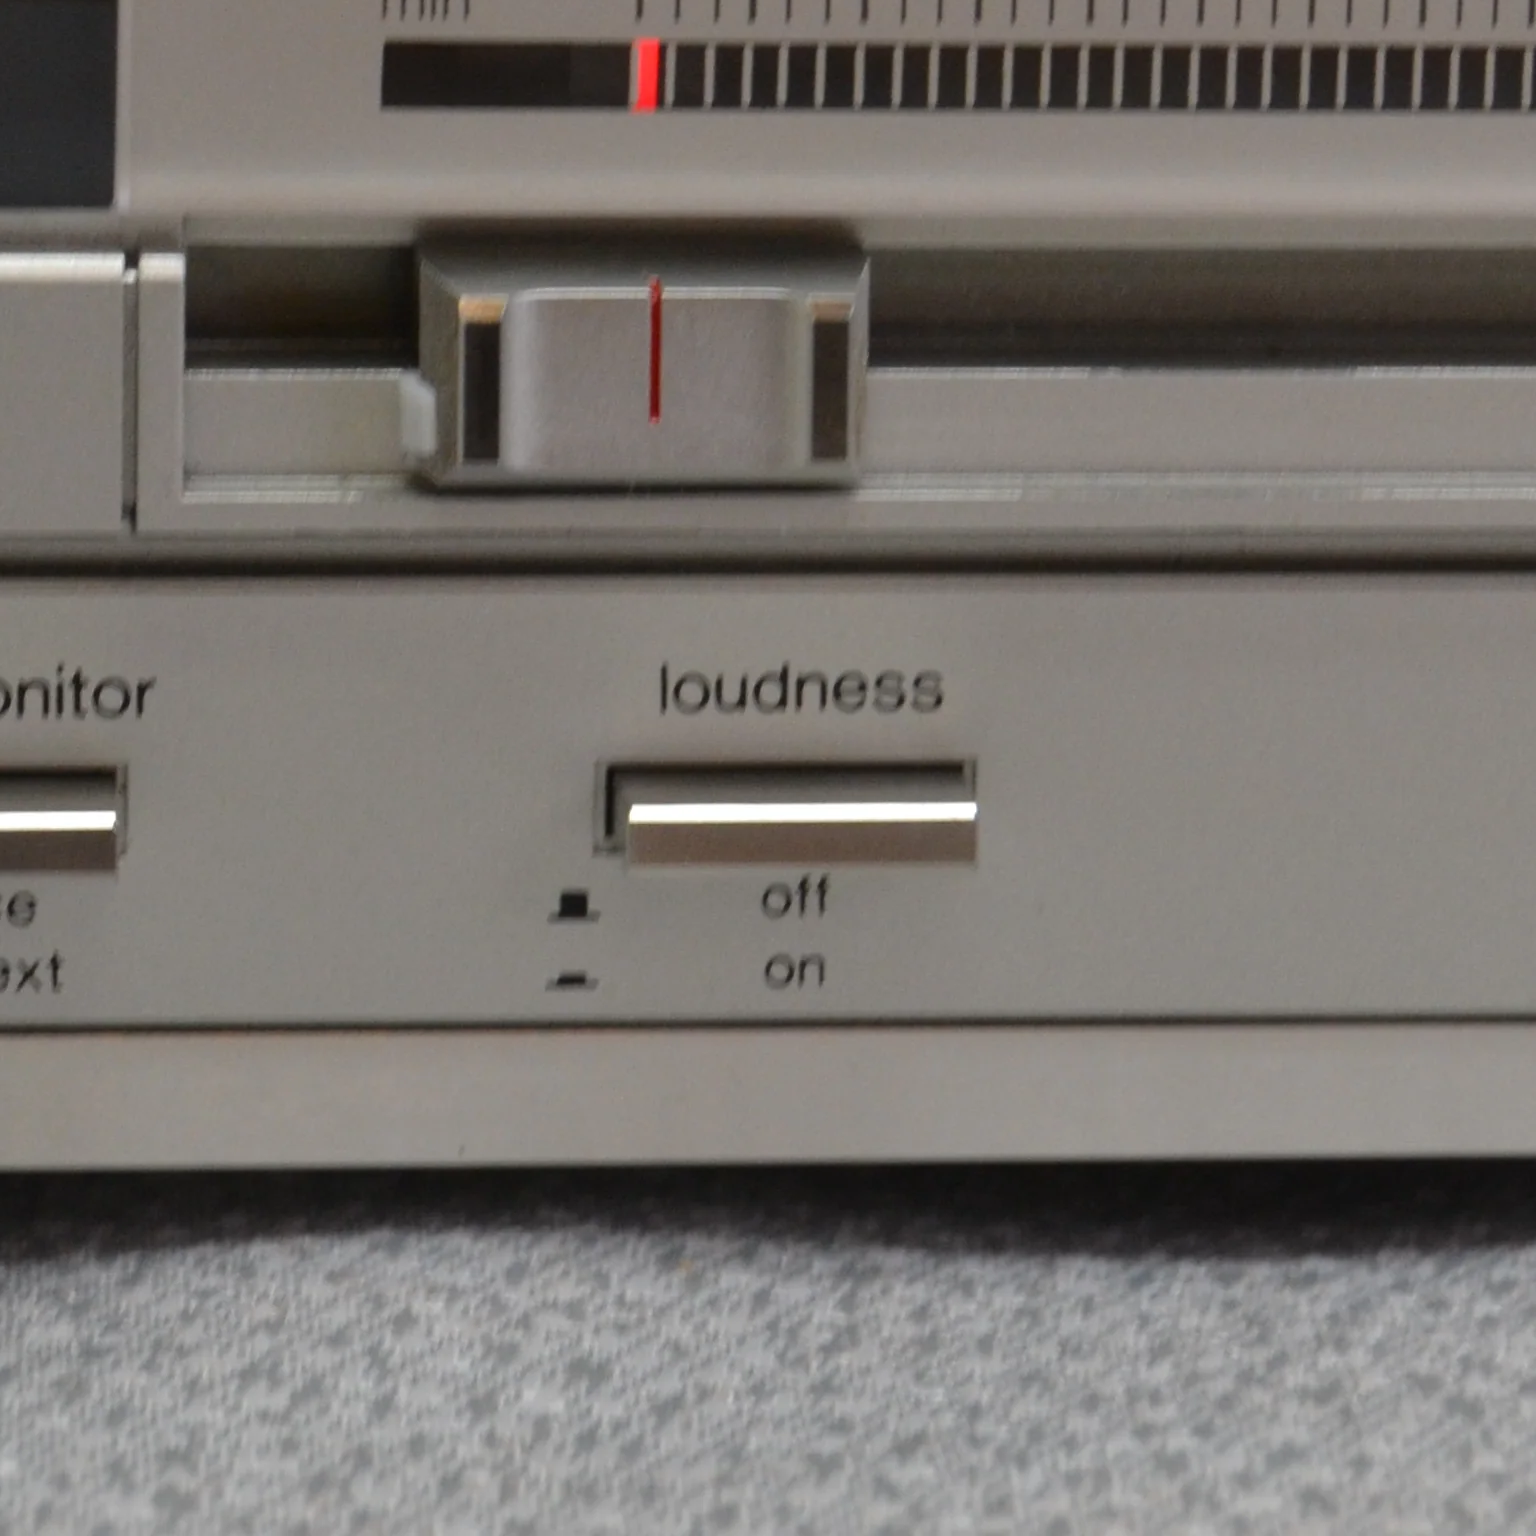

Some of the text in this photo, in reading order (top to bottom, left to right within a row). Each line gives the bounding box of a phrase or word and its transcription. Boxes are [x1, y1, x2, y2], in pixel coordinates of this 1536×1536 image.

[660, 663, 946, 716] loudness
[759, 871, 832, 922] off
[761, 952, 828, 991] on
